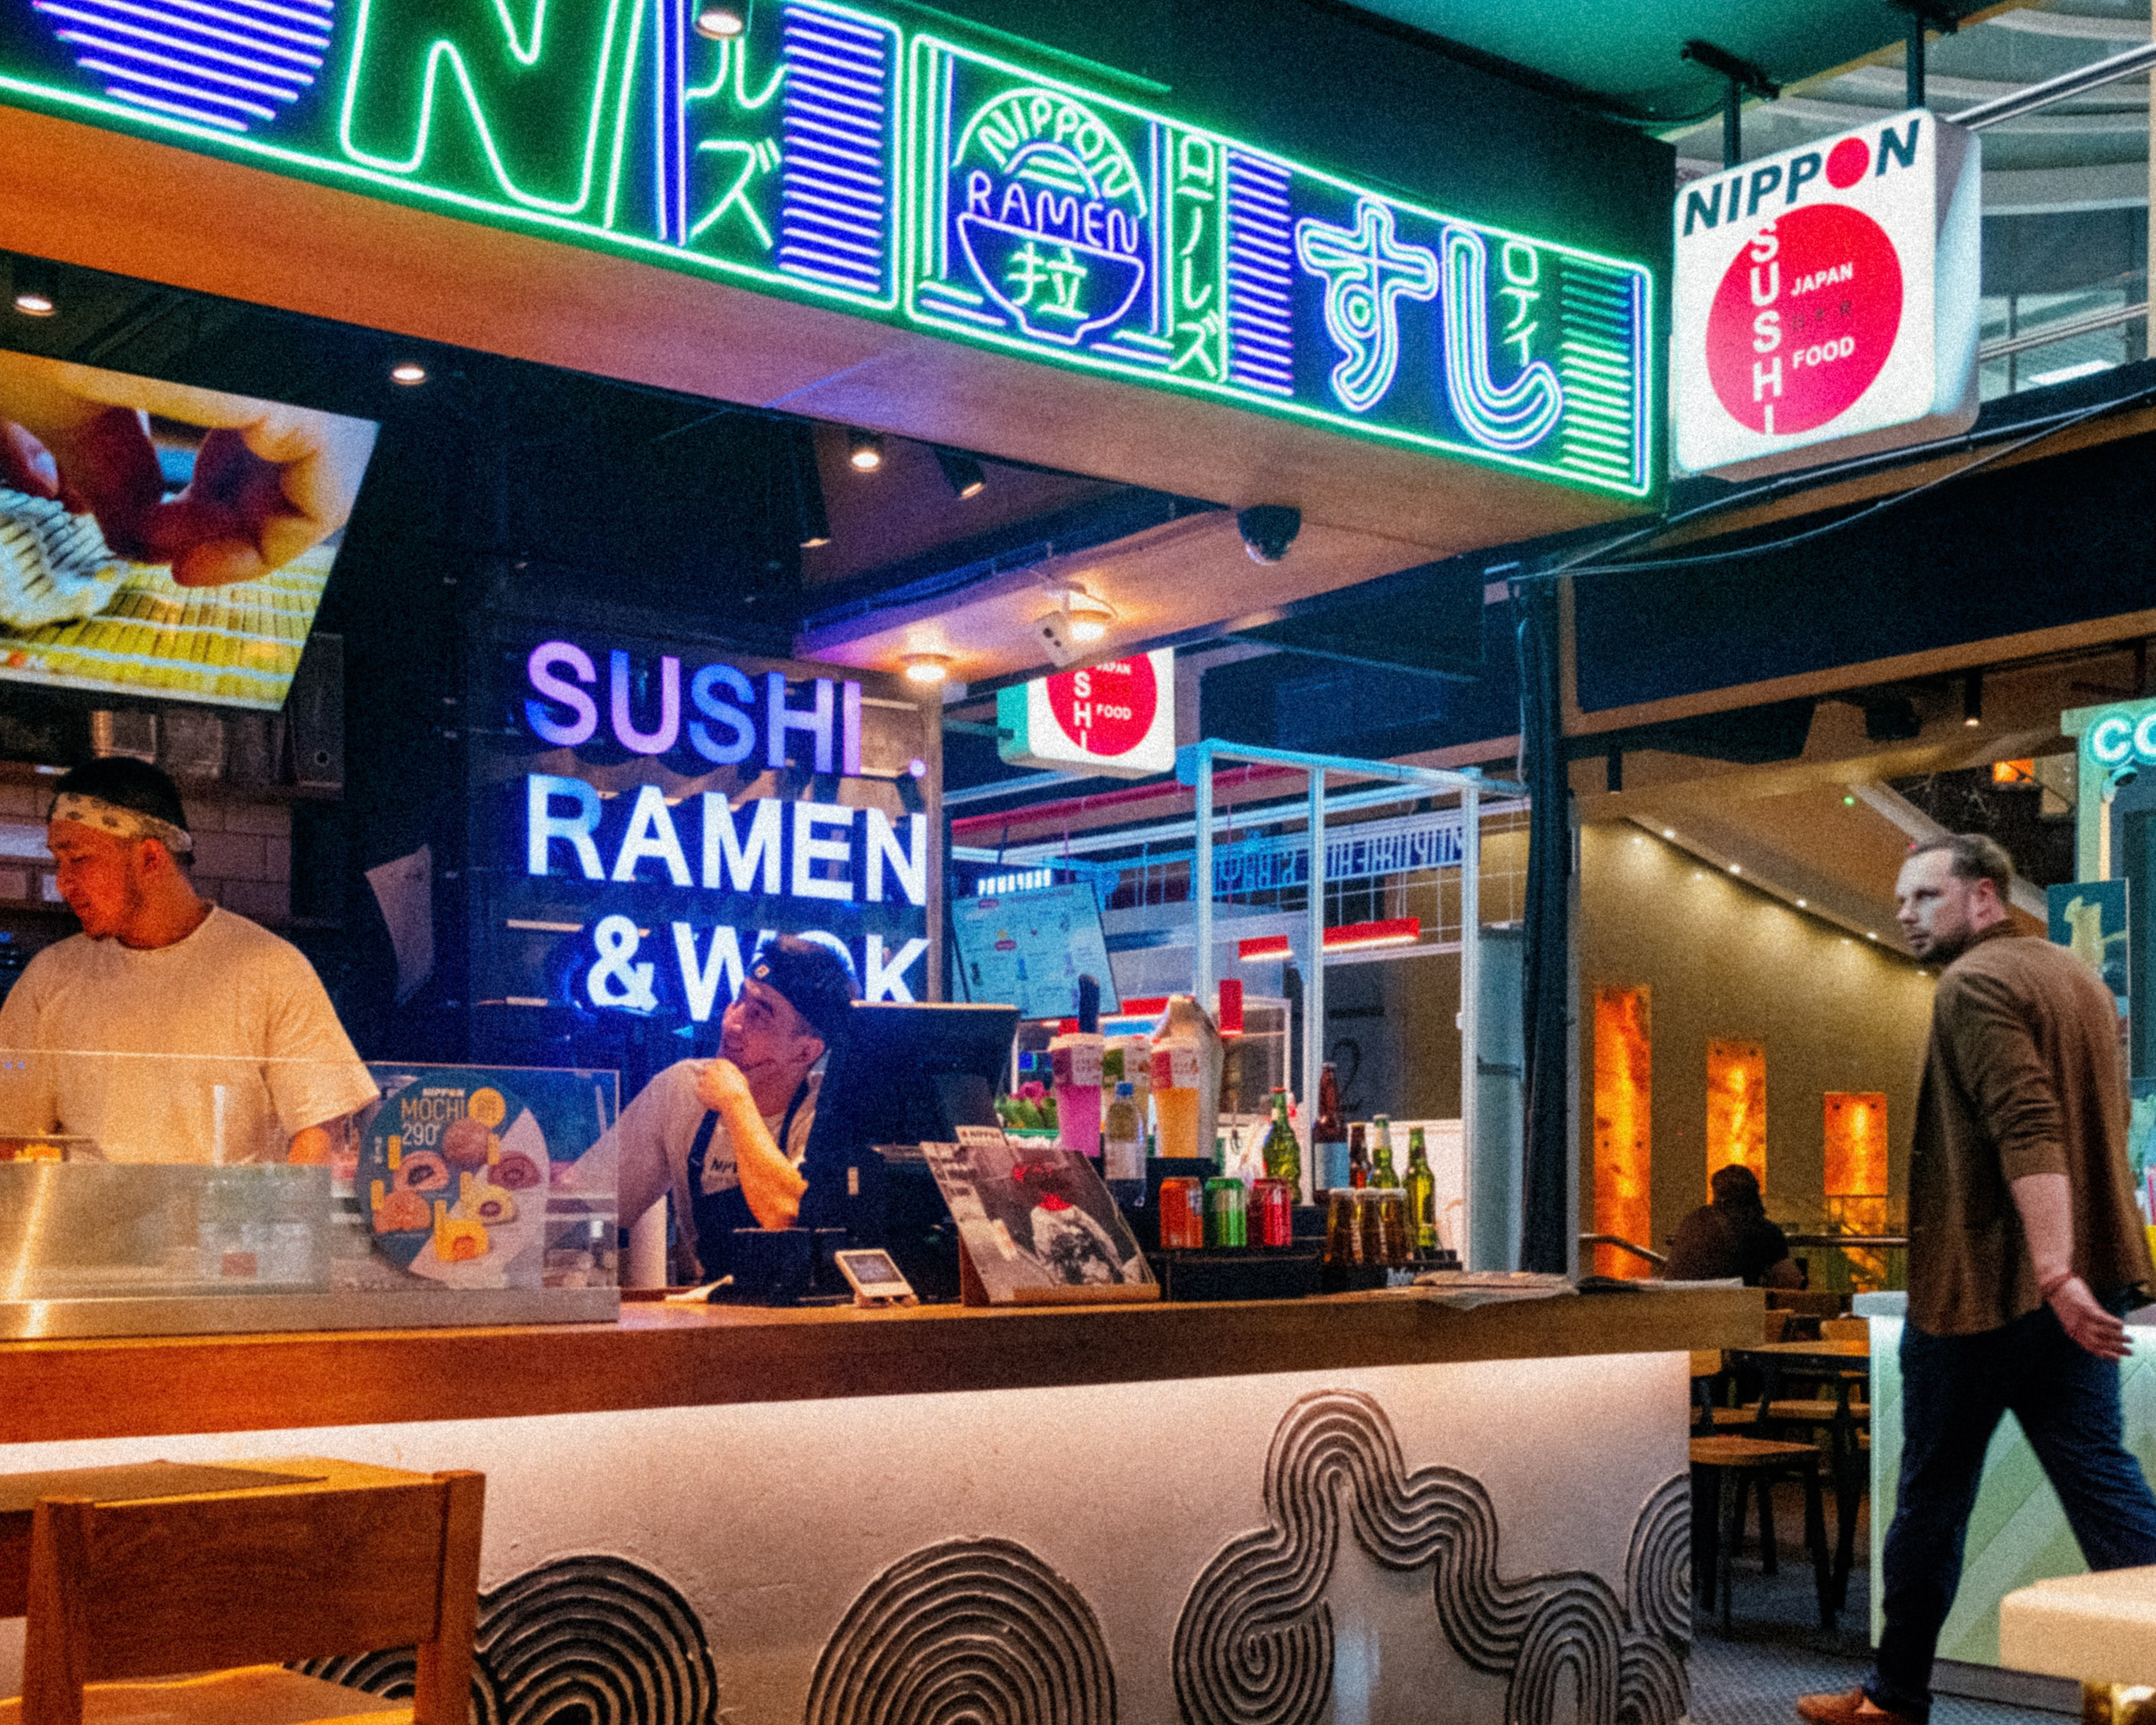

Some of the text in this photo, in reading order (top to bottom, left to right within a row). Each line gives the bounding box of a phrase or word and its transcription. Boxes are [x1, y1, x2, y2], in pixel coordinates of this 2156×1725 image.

[980, 94, 1134, 200] NIPPON
[1682, 118, 1919, 237] NIPPON
[967, 168, 1140, 254] RAMEN
[1004, 241, 1090, 321] 拉
[1294, 196, 1564, 451] すし
[1748, 221, 1784, 435] SUSHI
[1790, 261, 1854, 296] JAPAN
[1792, 335, 1855, 371] FOOD
[524, 640, 862, 777] SUSHI
[1096, 704, 1132, 720] FOOD
[526, 773, 929, 907] RAMEN
[585, 915, 931, 1023] & WK
[400, 1097, 467, 1122] MOCHI
